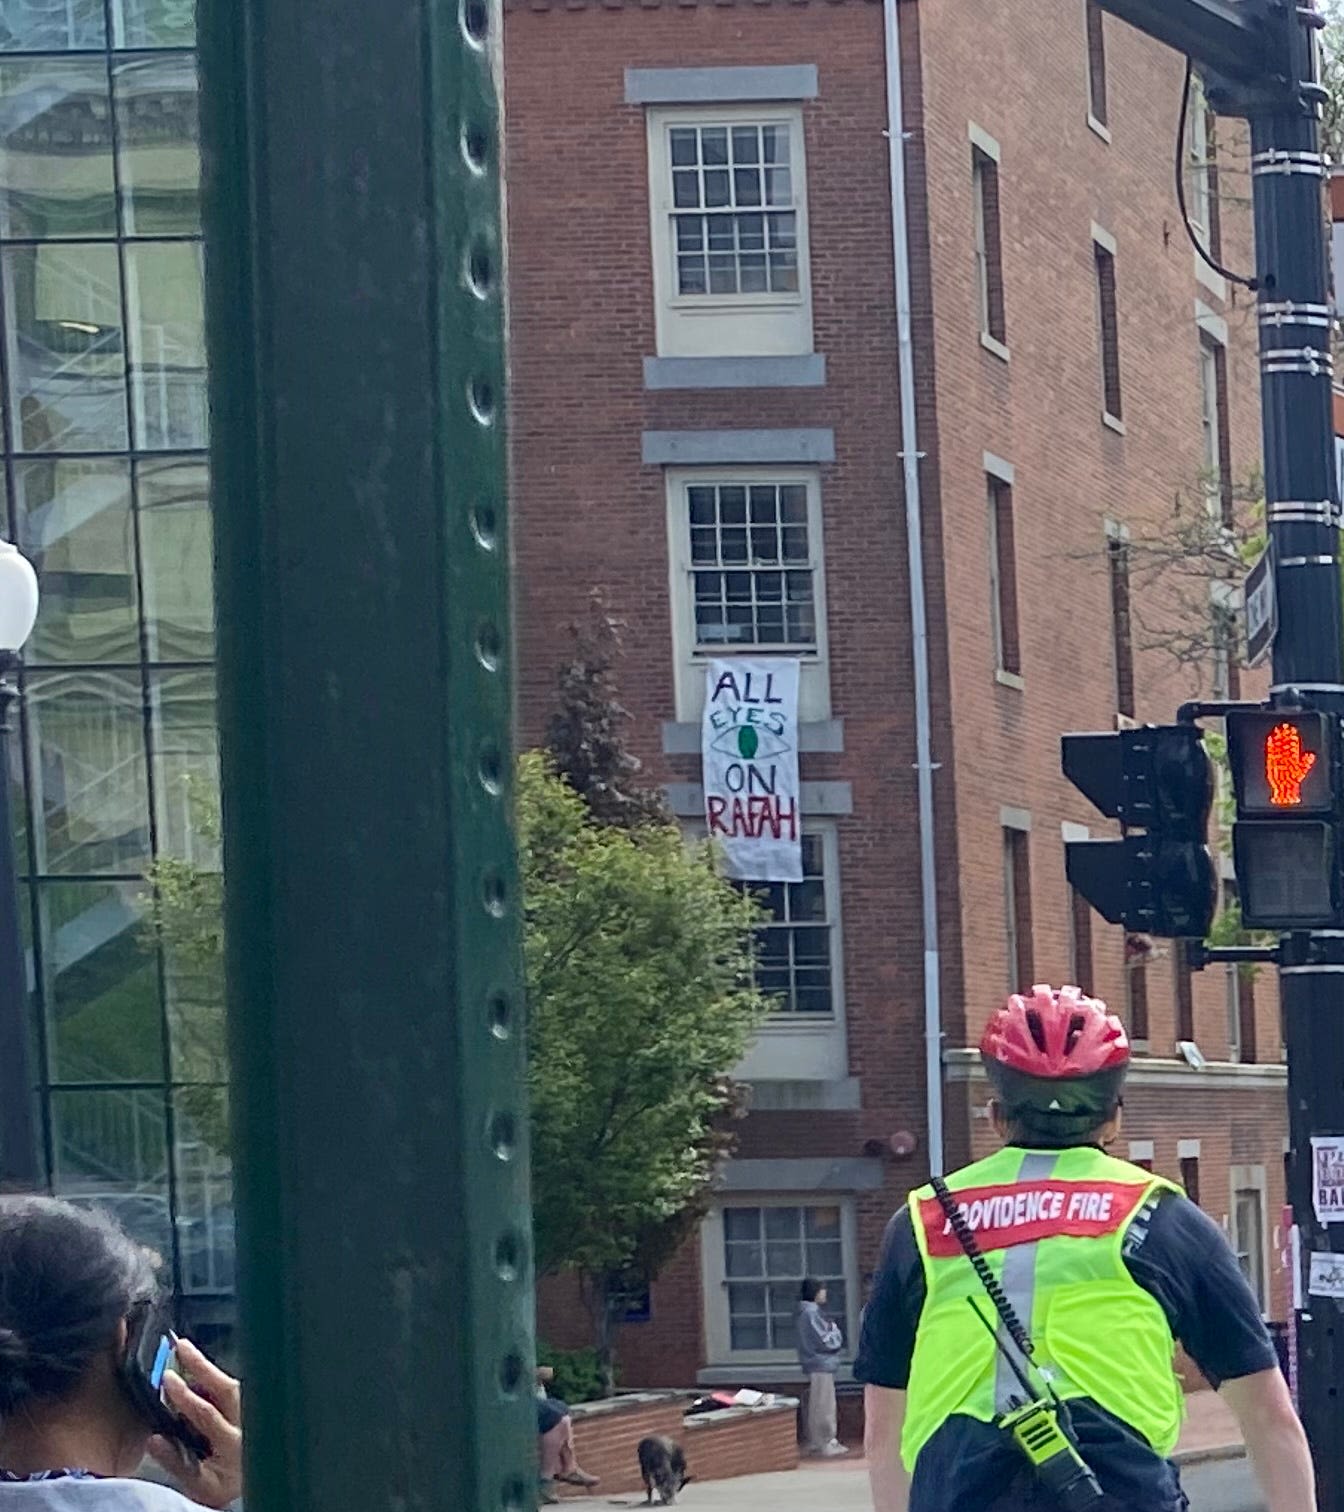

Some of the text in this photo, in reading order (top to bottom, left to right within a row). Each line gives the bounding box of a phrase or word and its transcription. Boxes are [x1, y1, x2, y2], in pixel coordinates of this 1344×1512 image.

[711, 671, 782, 704] ALL
[709, 706, 787, 736] EYES
[725, 763, 776, 794] ON
[707, 796, 796, 841] RAFAH
[1067, 1192, 1114, 1221] FIRE
